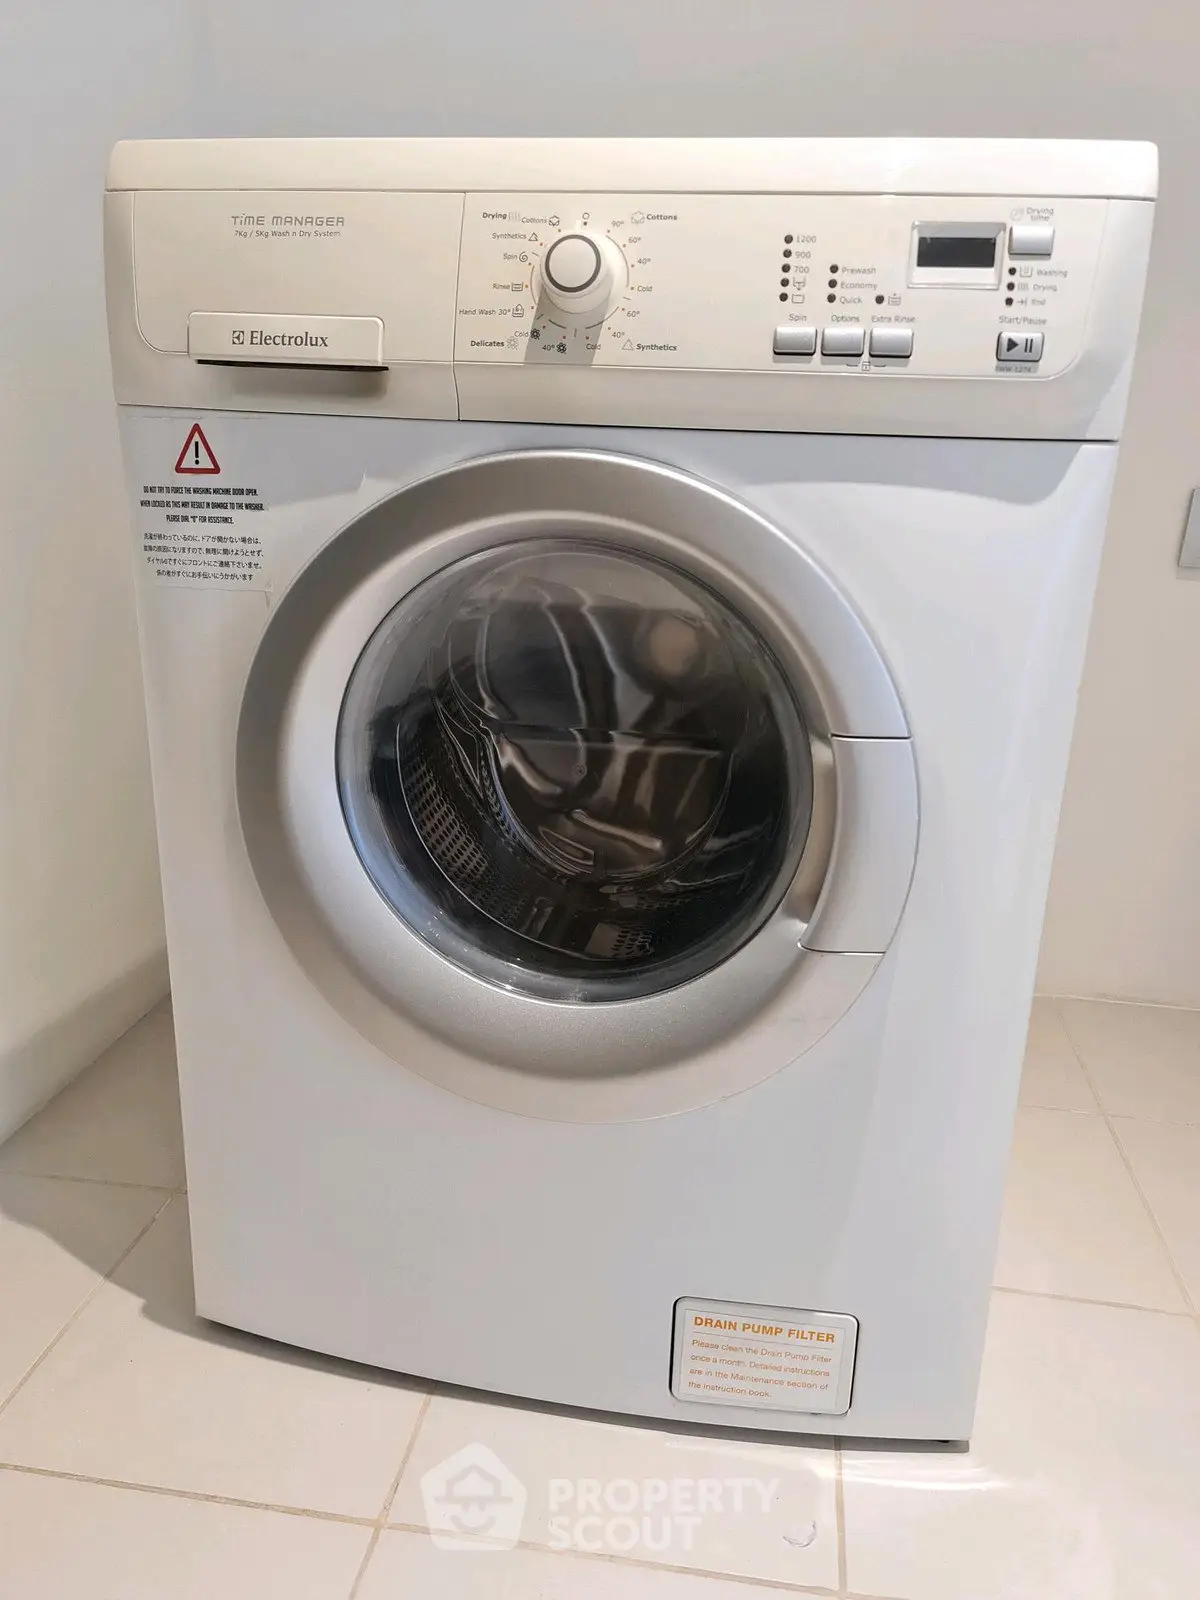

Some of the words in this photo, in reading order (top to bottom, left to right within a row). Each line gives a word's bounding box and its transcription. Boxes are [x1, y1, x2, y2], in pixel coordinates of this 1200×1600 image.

[1026, 207, 1054, 216] Drying
[482, 212, 508, 220] Drying
[272, 216, 345, 226] MANAGER
[234, 230, 248, 238] 7Kg
[256, 230, 268, 238] 5Kg
[492, 232, 527, 240] Synthetics
[503, 253, 518, 261] Spin
[842, 266, 876, 274] Prewash
[1036, 269, 1068, 278] Washing
[840, 282, 878, 290] Economy
[1032, 284, 1058, 292] Drying
[840, 296, 862, 304] Quick
[788, 314, 807, 322] Spin
[830, 314, 860, 323] Options
[871, 314, 892, 322] Extra
[999, 316, 1048, 326] Start/Pause
[250, 331, 328, 348] Electrolux
[636, 344, 678, 352] Synthetics
[693, 1316, 738, 1331] DRAIN
[742, 1323, 784, 1336] PUMP
[787, 1328, 836, 1343] FILTER
[692, 1339, 720, 1350] Please
[721, 1344, 744, 1352] clean
[746, 1346, 758, 1355] the
[760, 1348, 782, 1358] Drain
[784, 1352, 809, 1362] Pump
[811, 1354, 832, 1364] Filter
[690, 1354, 710, 1363] once
[719, 1358, 746, 1367] month.
[750, 1361, 782, 1372] Detailed
[784, 1364, 830, 1377] instructions
[704, 1369, 712, 1377] in
[714, 1370, 728, 1379] the
[730, 1372, 784, 1386] Maintenance
[786, 1379, 818, 1389] section
[820, 1382, 828, 1390] of
[688, 1381, 701, 1389] the
[703, 1382, 746, 1395] instruction
[748, 1390, 772, 1398] book.
